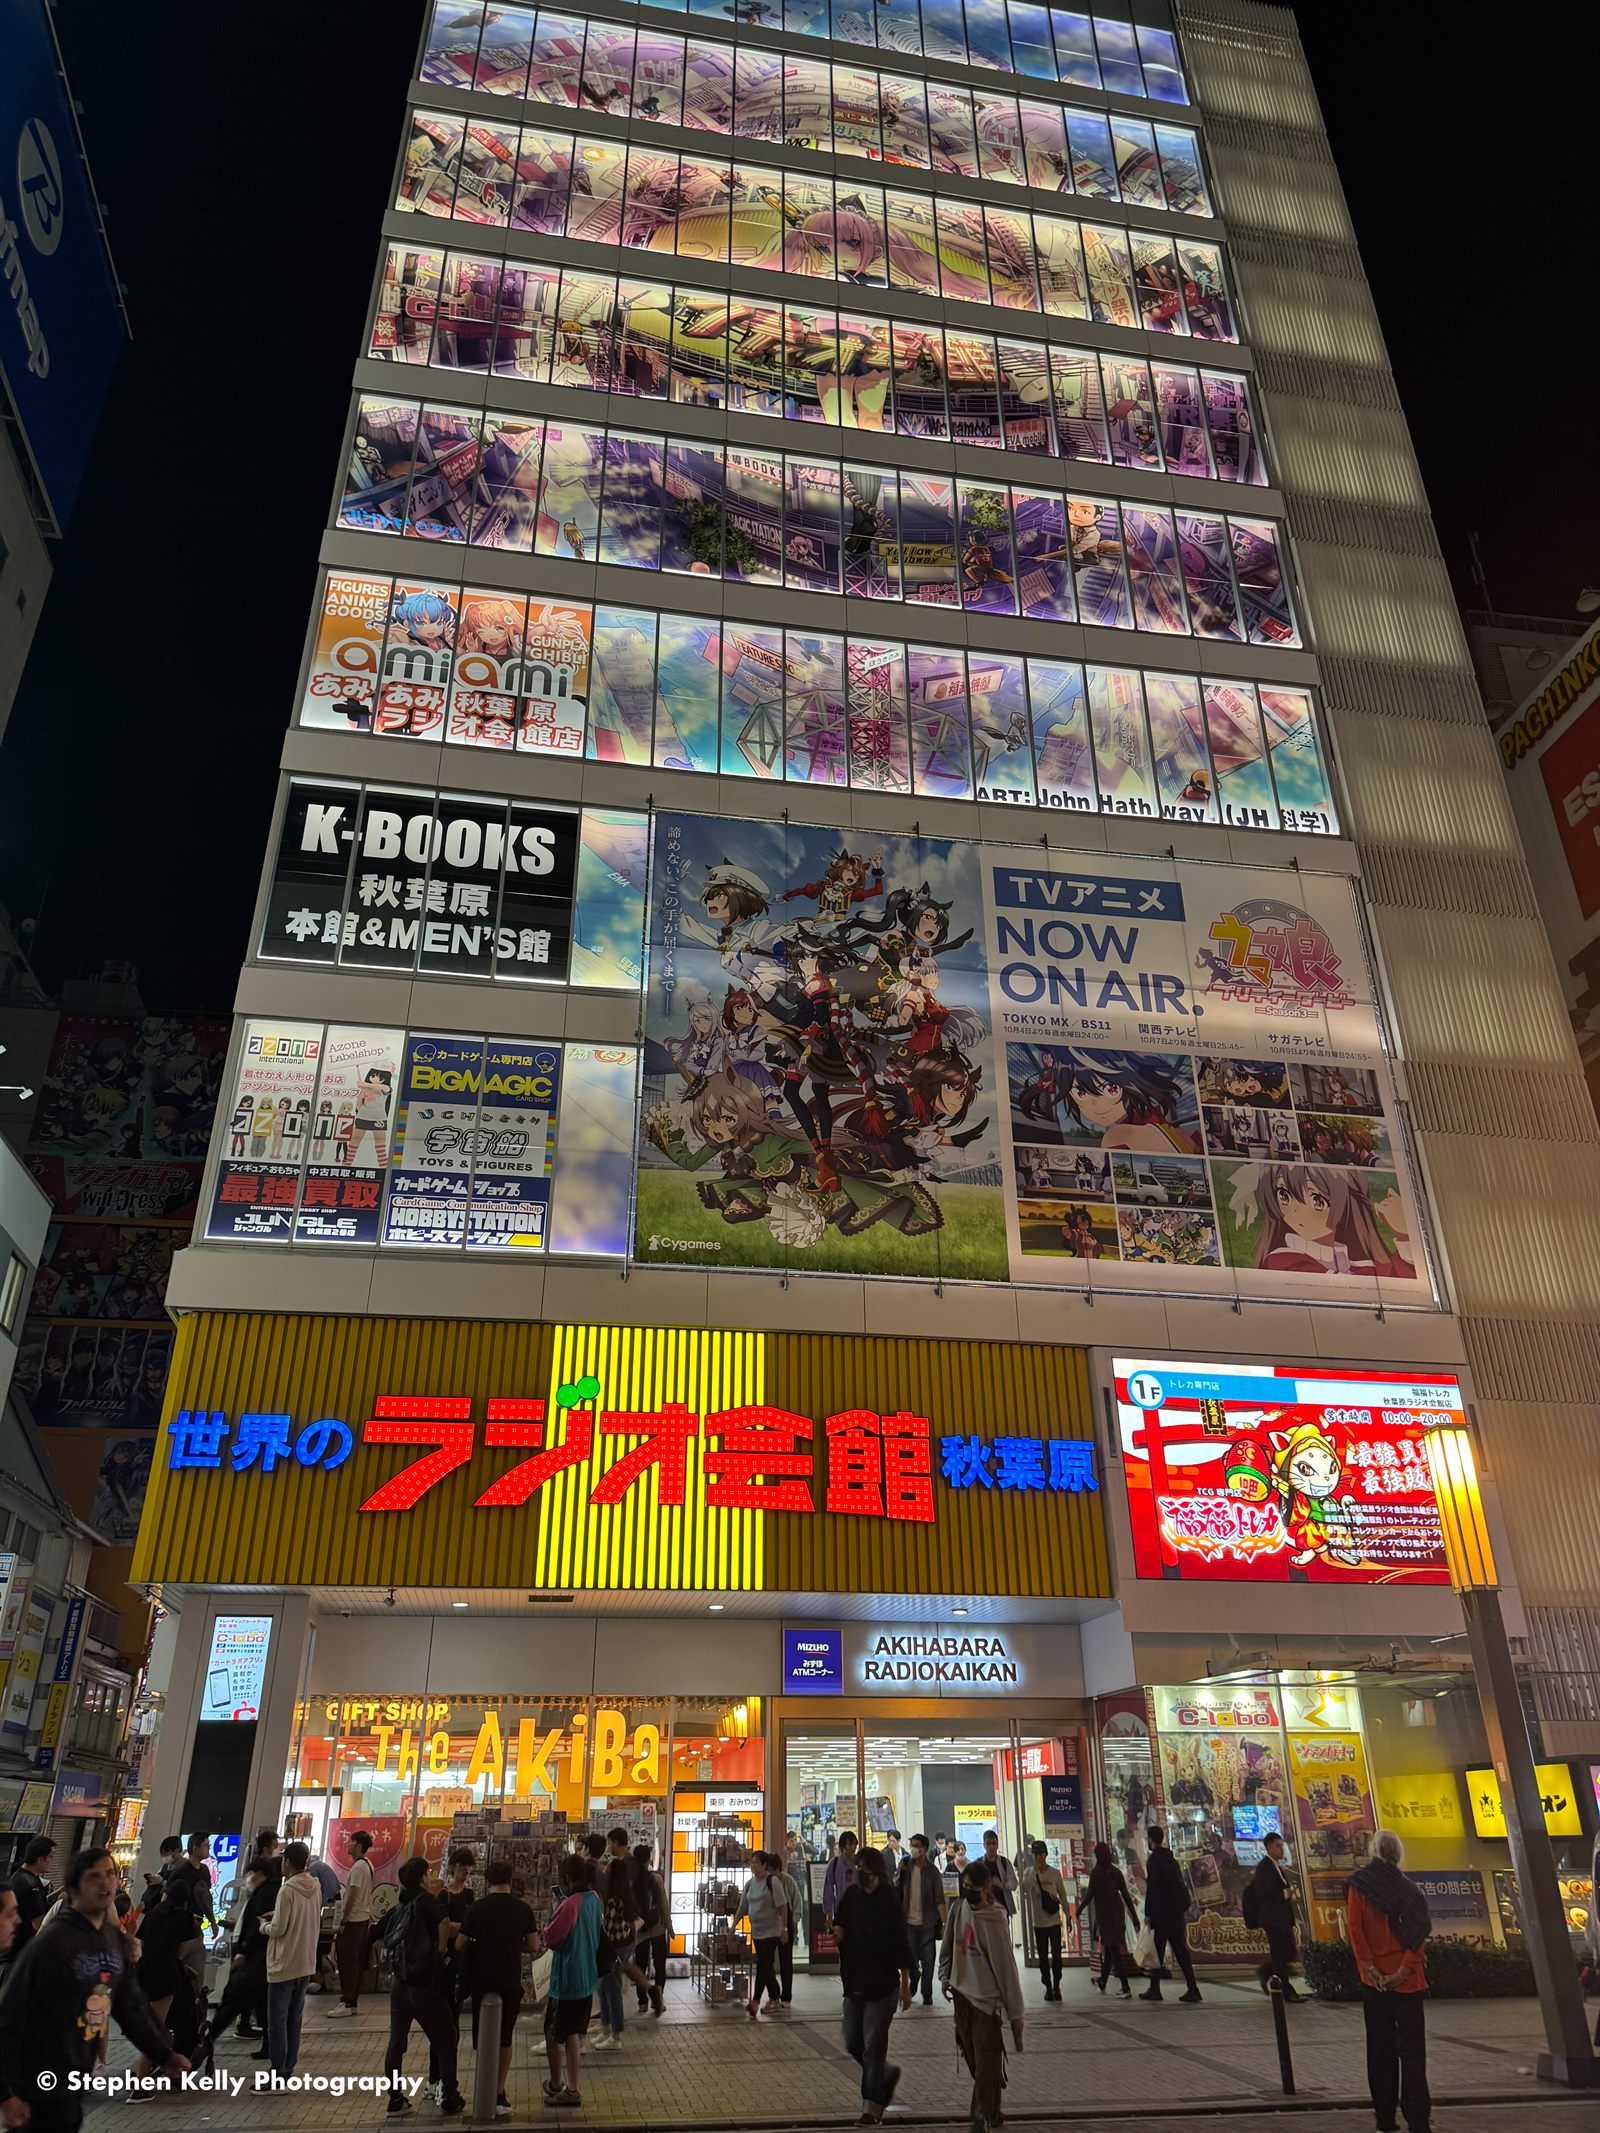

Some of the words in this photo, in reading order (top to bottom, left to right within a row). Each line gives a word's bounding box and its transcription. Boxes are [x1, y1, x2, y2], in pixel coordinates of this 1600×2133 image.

[329, 580, 389, 597] FIGURES
[327, 593, 384, 609] ANIME
[324, 605, 385, 622] GOODS
[530, 634, 588, 653] GUNPLA
[528, 648, 588, 668] GHIBLI
[1039, 788, 1091, 810] John
[300, 803, 556, 876] K-BOOKS
[358, 874, 492, 917] 秋葉原
[1008, 875, 1166, 913] TVアニメ
[996, 916, 1139, 965] NOW
[1000, 962, 1088, 1008] ON
[1096, 969, 1204, 1017] AIR.
[1002, 1013, 1046, 1026] TOKYO
[1138, 1023, 1198, 1038] 関西テレビ
[328, 1038, 368, 1054] Azone
[1268, 1033, 1326, 1048] サガテレビ
[329, 1047, 385, 1064] Labelshop
[436, 1049, 534, 1067] カードゲーム専門店
[424, 1126, 531, 1159] 宇宙船
[418, 1157, 455, 1168] TOYS
[459, 1159, 470, 1169] &
[475, 1160, 534, 1172] FIGURES
[220, 1174, 380, 1208] 最強買取
[392, 1196, 445, 1208] CardGame
[519, 1203, 545, 1215] Shop
[234, 1211, 358, 1230] JUNGLE
[660, 1237, 722, 1252] Cygames
[1169, 1378, 1221, 1392] トレカ専門店
[166, 1411, 354, 1475] 世界の
[356, 1376, 936, 1524] ラジオ会館
[940, 1433, 1102, 1496] 秋葉原
[1361, 1466, 1433, 1496] 最強販
[1197, 1488, 1215, 1496] TCG
[216, 1634, 265, 1643] C-labo
[796, 1642, 830, 1652] MIZUHO
[874, 1636, 1006, 1657] AKIHABARA
[792, 1668, 834, 1677] ATMコーナー
[802, 1659, 824, 1668] みずほ
[864, 1661, 1018, 1682] RADIOKAIKAN
[326, 1702, 380, 1722] GIFT
[384, 1702, 450, 1722] SHOP
[1175, 1708, 1271, 1727] C-labo
[370, 1725, 450, 1781] The
[709, 1797, 725, 1807] 東京
[729, 1797, 759, 1807] おみやげ
[216, 1836, 238, 1857] 1F
